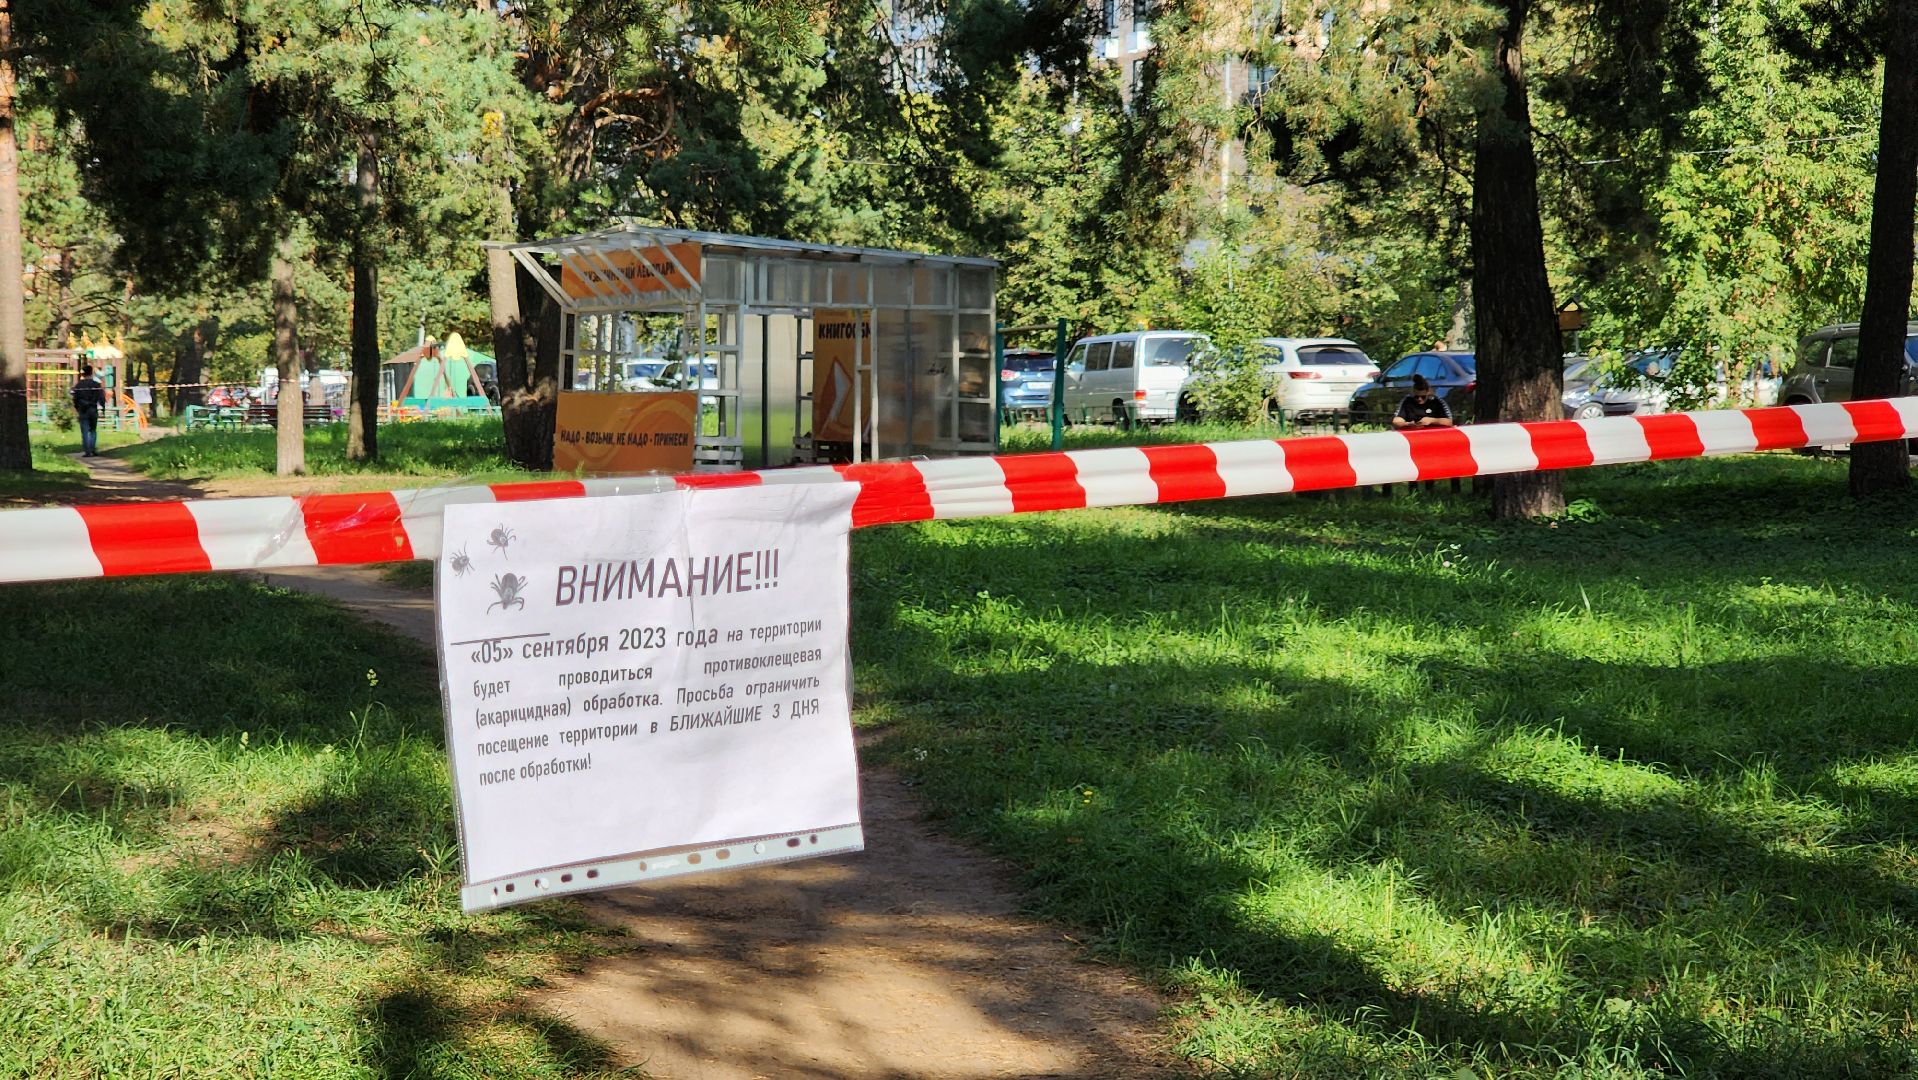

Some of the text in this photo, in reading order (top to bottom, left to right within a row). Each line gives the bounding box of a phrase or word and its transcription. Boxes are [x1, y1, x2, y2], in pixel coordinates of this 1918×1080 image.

[561, 430, 580, 445] НАДО
[617, 433, 625, 445] НЕ
[628, 433, 648, 447] НАДО
[654, 432, 688, 446] ПРИНЕСИ
[555, 548, 780, 607] ВНИМАНИЕ!!!
[471, 617, 822, 664] «05» сентября 2023 года на территории
[473, 648, 822, 698] будет проводиться противоклещевая
[475, 676, 820, 728] (акарицидная) обработка. Просьба ограничить
[477, 698, 820, 756] посещение территории в БЛИЖАЙШИЕ 3 ДНЯ
[479, 753, 592, 786] после обработки!
